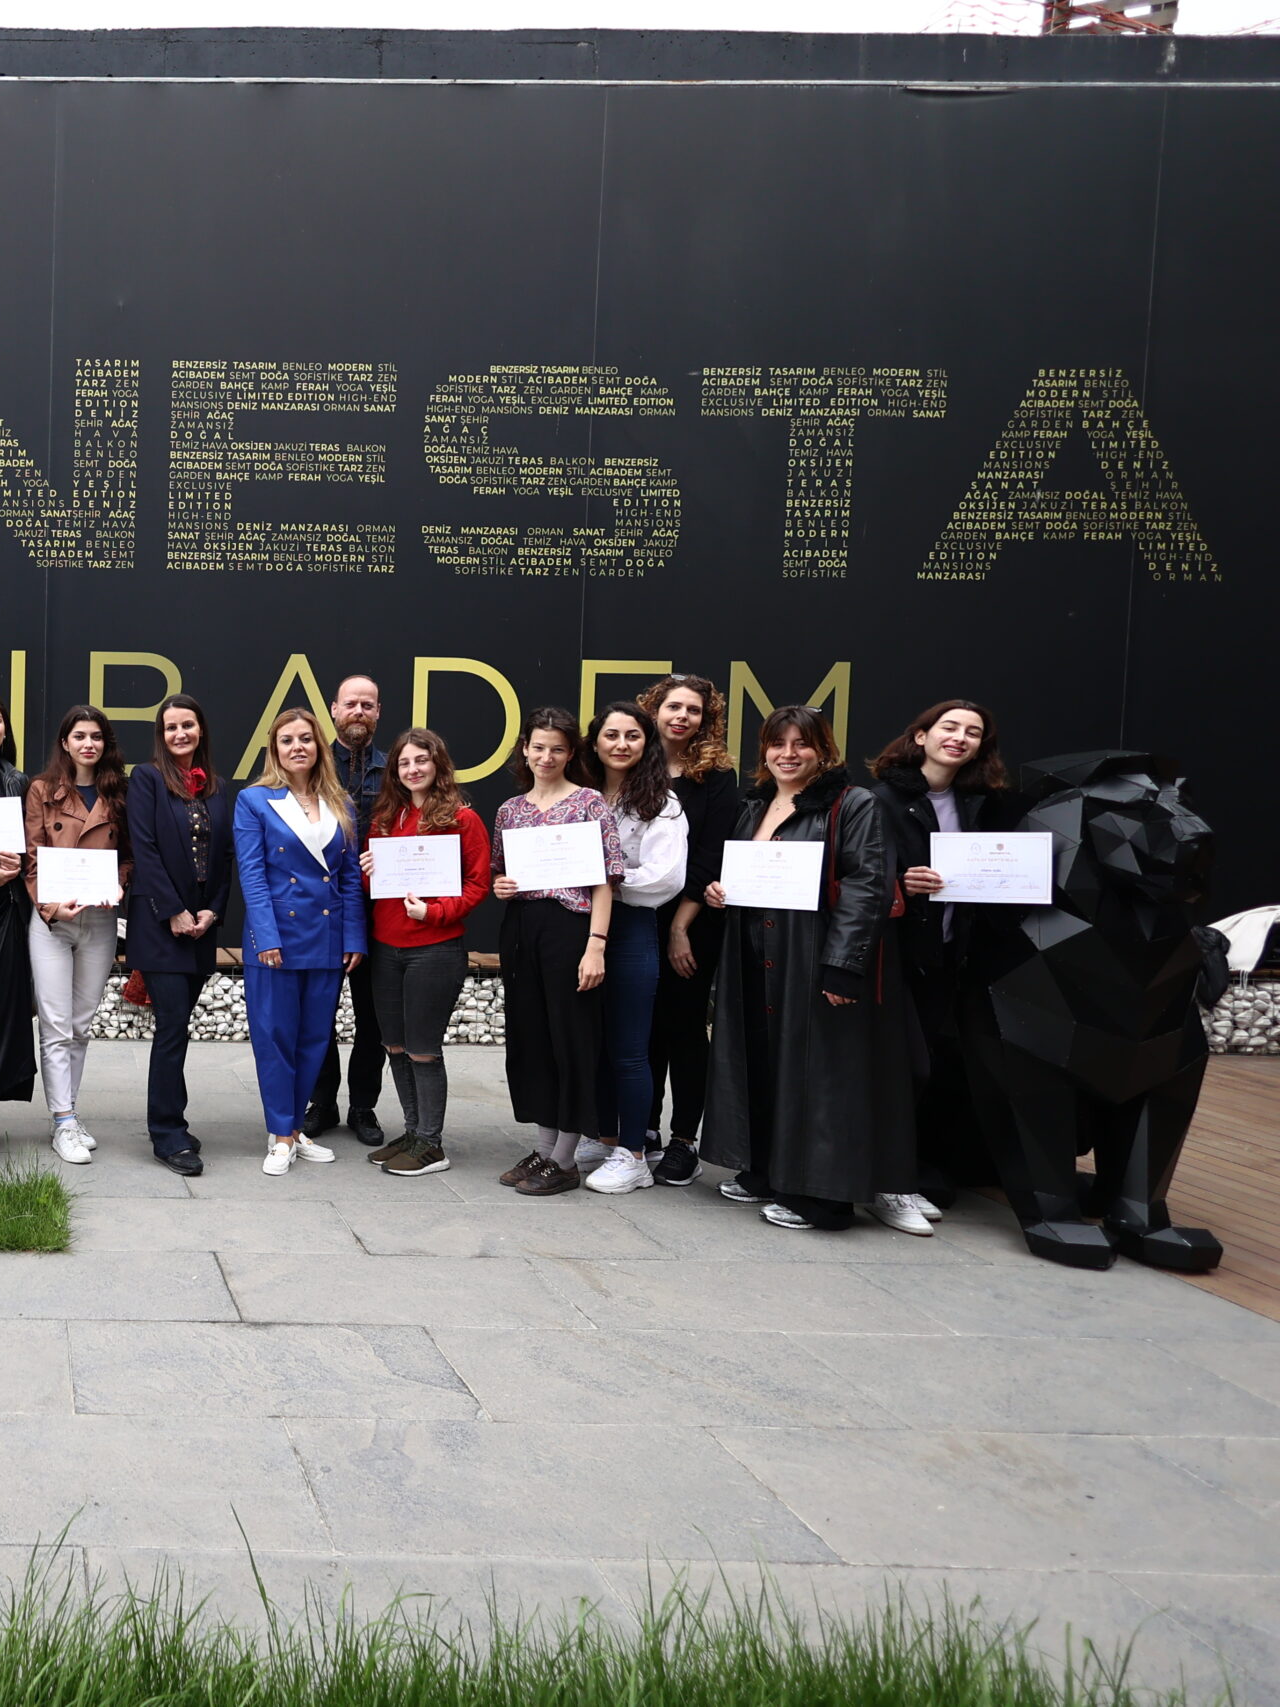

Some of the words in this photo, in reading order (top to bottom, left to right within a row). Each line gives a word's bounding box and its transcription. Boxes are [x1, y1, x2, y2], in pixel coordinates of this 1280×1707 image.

[490, 364, 538, 373] BENZERSİZ
[703, 366, 761, 376] BENZERSİZ
[927, 368, 948, 377] STİL
[260, 371, 289, 380] DOĞA
[294, 371, 342, 380] SOFİSTİKE
[436, 383, 483, 392] SOFİSTİKE
[600, 387, 632, 397] BAHÇE
[755, 388, 790, 398] BAHÇE
[918, 388, 946, 400] YEŞİL
[228, 400, 257, 410] DENİZ
[500, 394, 525, 406] YEŞİL
[1109, 398, 1138, 408] DOĞA
[762, 407, 792, 416] DENİZ
[790, 417, 820, 428] ŞEHİR
[827, 417, 854, 428] AĞAÇ
[1126, 429, 1153, 440] YEŞİL
[424, 444, 458, 453] DOĞAL
[461, 444, 490, 454] TEMİZ
[786, 498, 850, 507] BENZERSİZ
[954, 510, 1013, 520] BENZERSİZ
[1168, 511, 1192, 520] STİL
[205, 530, 233, 542] ŞEHİR
[239, 531, 266, 543] AĞAÇ
[327, 532, 361, 542] DOĞAL
[366, 533, 395, 542] TEMİZ
[996, 532, 1034, 542] BAHÇE
[1171, 531, 1202, 543] YEŞİL
[518, 546, 571, 556] BENZERSİZ
[36, 558, 83, 568] SOFİSTİKE
[783, 568, 846, 578] SOFİSTİKE
